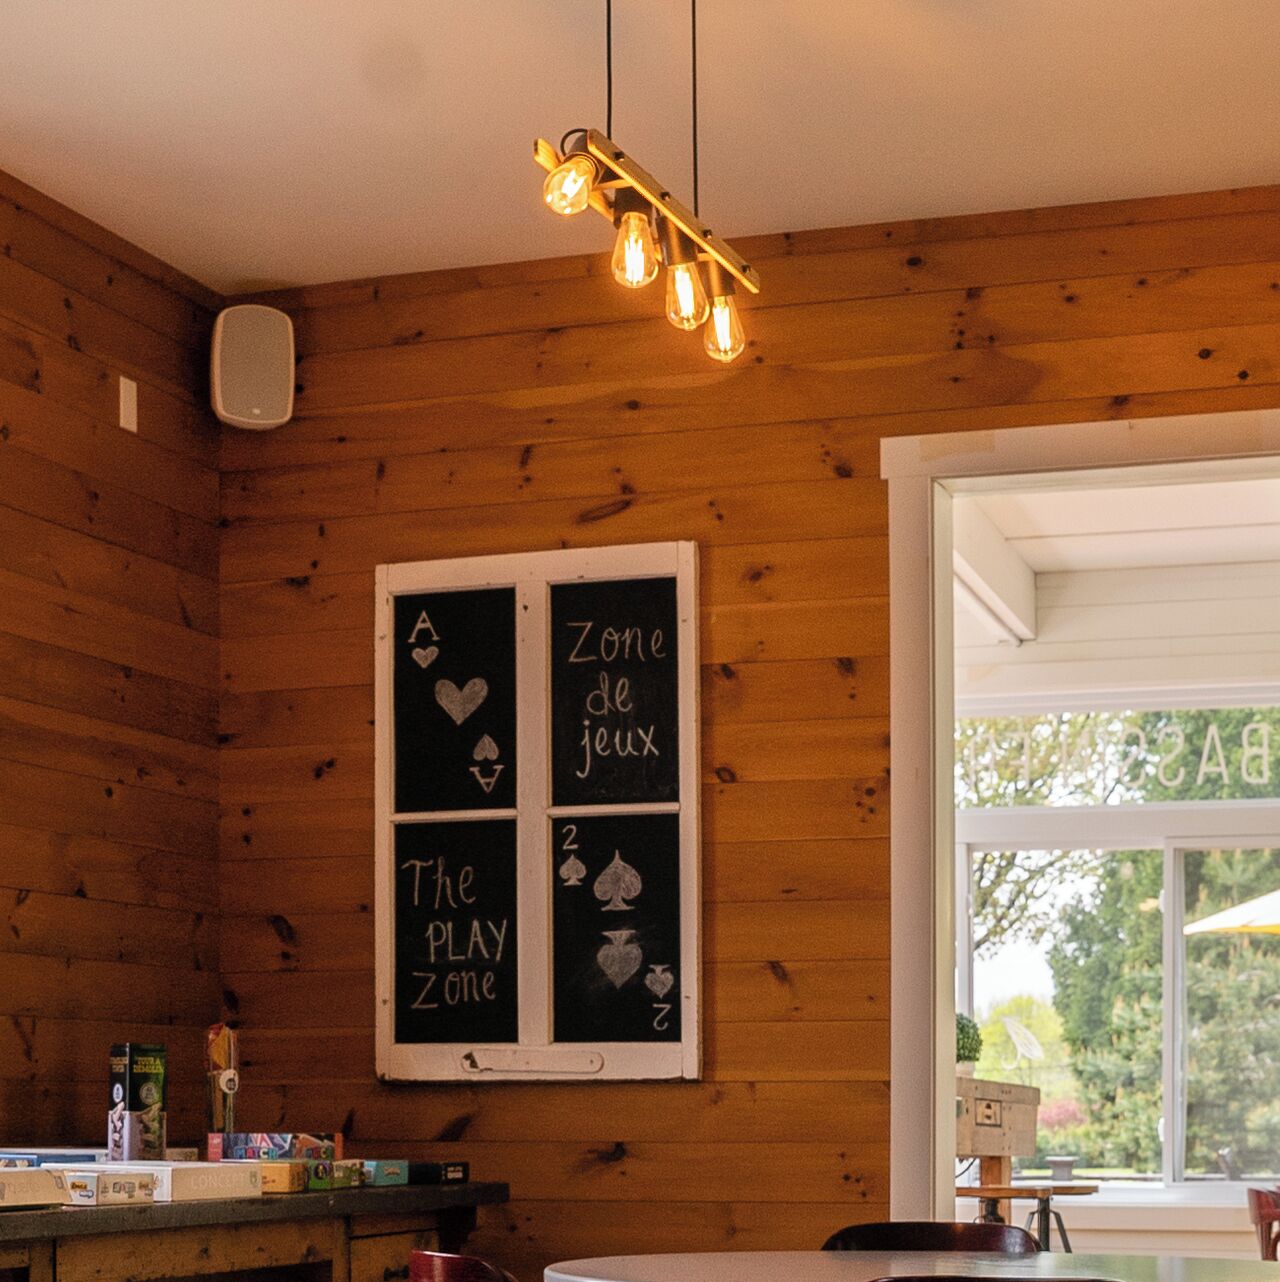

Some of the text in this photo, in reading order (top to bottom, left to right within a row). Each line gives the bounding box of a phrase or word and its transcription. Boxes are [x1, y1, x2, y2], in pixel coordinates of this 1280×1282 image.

[408, 610, 440, 643] A
[567, 621, 666, 663] Zone
[586, 671, 634, 716] de
[576, 719, 660, 779] jeux
[562, 824, 579, 849] 2
[401, 856, 476, 910] The
[425, 918, 507, 964] PLAY
